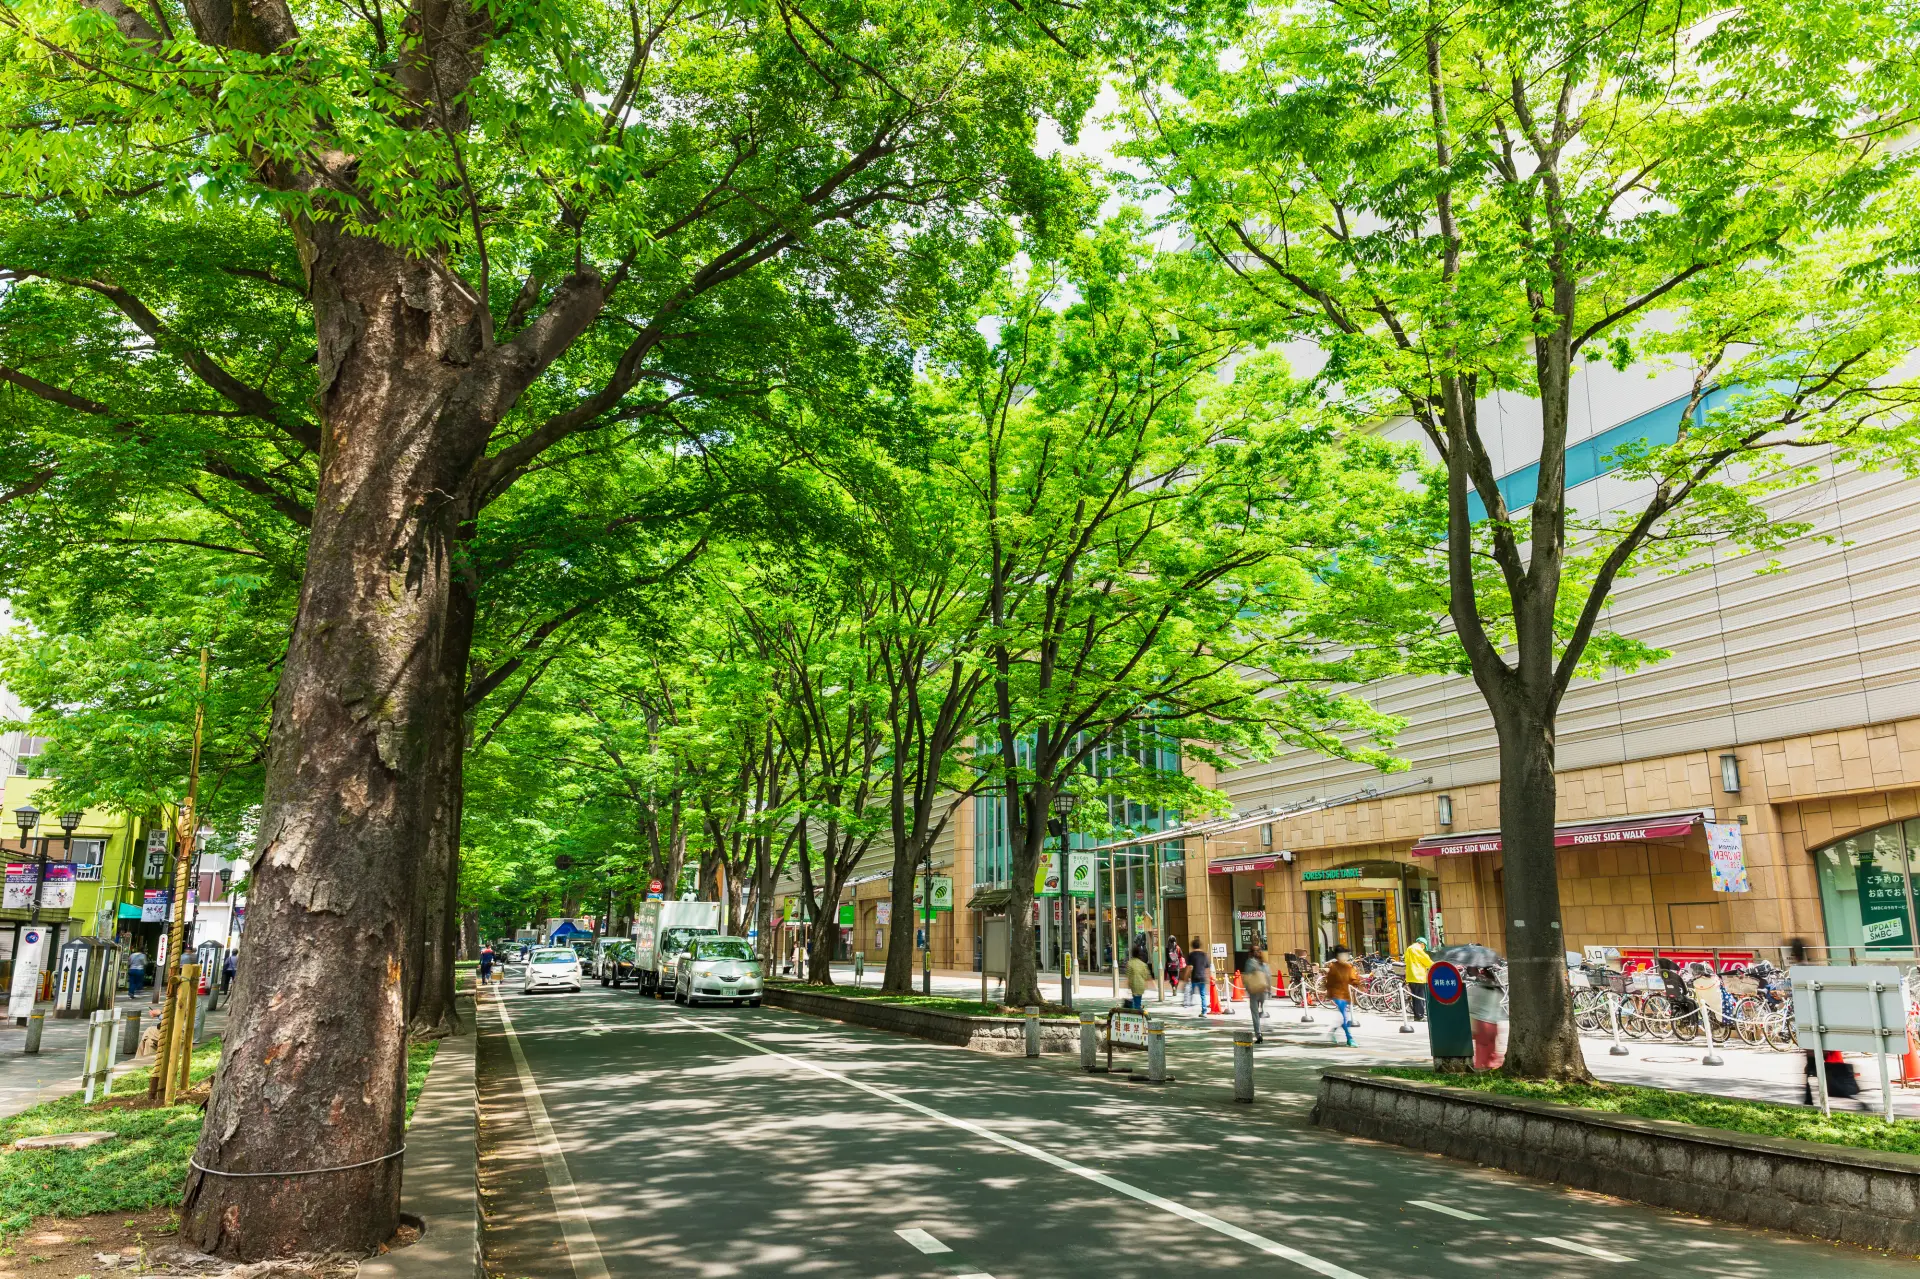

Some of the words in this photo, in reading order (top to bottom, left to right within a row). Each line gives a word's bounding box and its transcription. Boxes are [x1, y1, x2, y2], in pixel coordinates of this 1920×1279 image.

[1574, 834, 1601, 844] FOREST
[1603, 832, 1621, 841] SIDE
[1622, 829, 1647, 839] WALK
[1441, 846, 1463, 855] FOREST
[1464, 844, 1479, 852] SIDE
[1479, 842, 1498, 851] WALK
[1222, 865, 1234, 873] FOREST
[1302, 871, 1325, 881] FOREST
[1325, 869, 1339, 880] SIDE
[1340, 867, 1359, 878] TABLE
[1868, 920, 1901, 933] UPDATE!
[1870, 929, 1892, 941] SMBC
[1212, 946, 1225, 954] 出口
[1587, 949, 1603, 960] 入口
[1433, 979, 1457, 987] 消防水利
